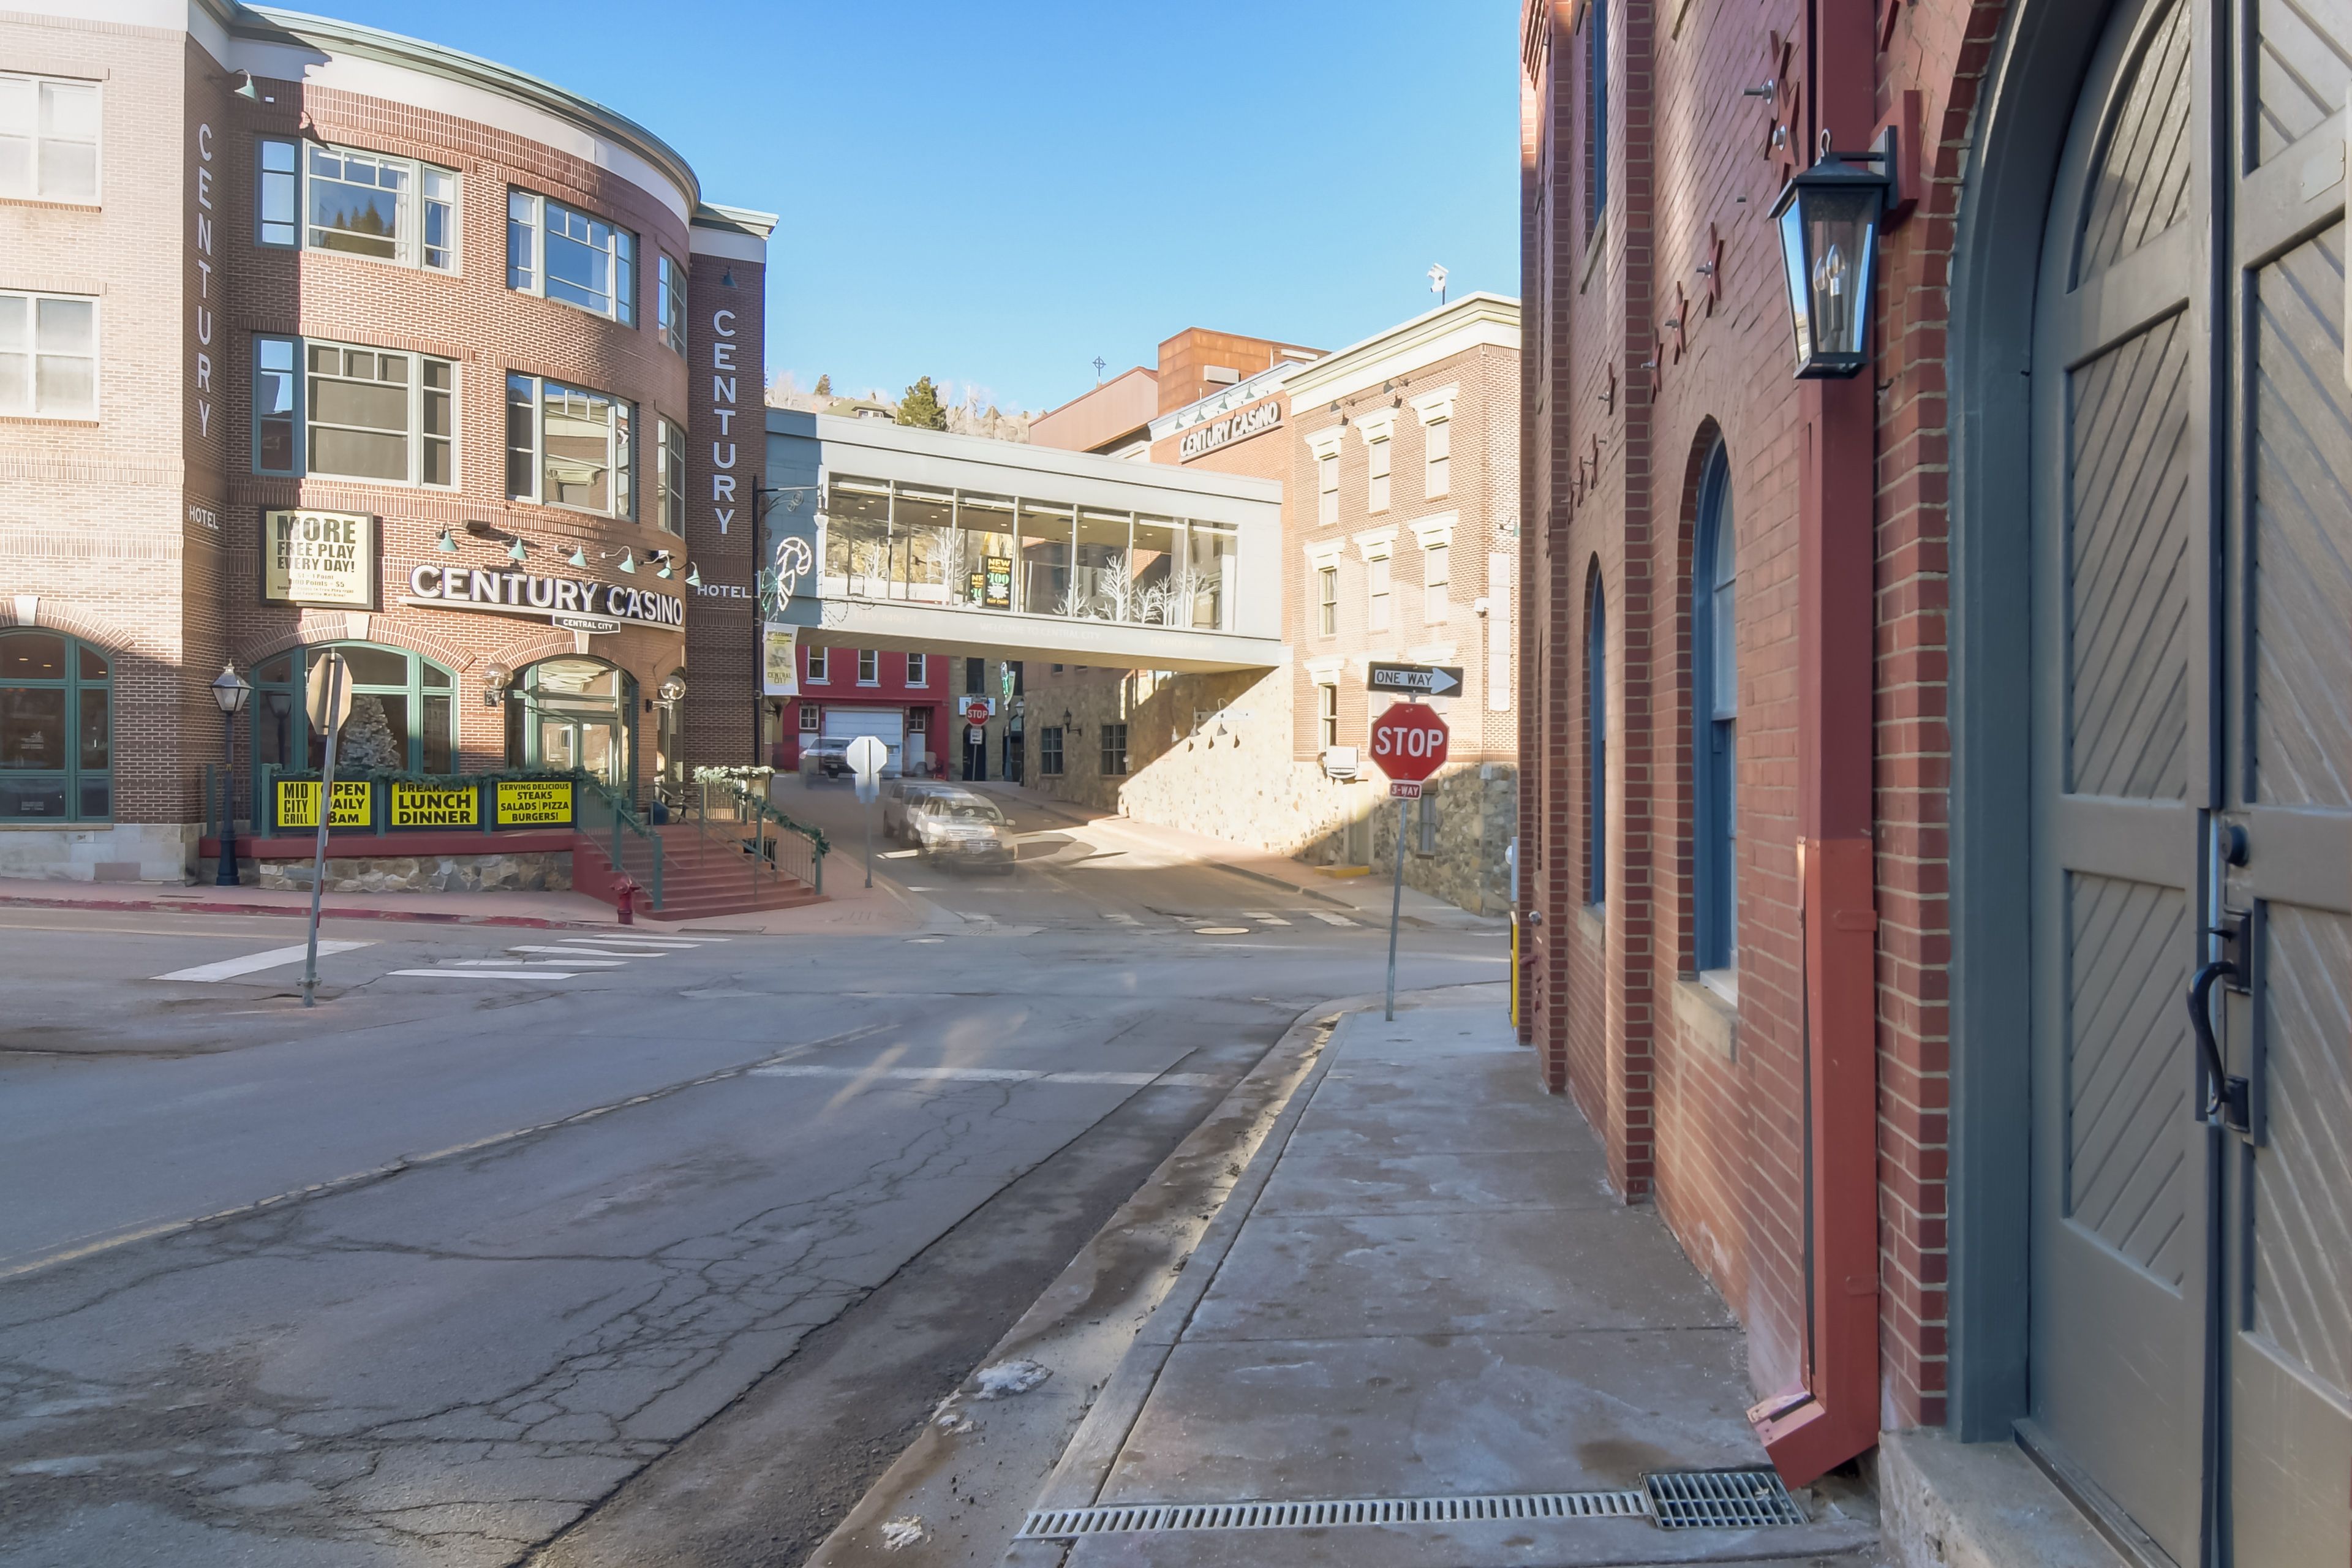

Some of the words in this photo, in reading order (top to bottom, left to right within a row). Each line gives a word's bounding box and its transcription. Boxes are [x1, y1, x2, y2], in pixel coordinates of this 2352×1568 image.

[198, 123, 213, 438] CENTURY
[713, 309, 736, 535] CENTURY
[1180, 419, 1231, 457] CENTURY
[1232, 401, 1278, 437] CASINO
[189, 504, 219, 530] HOTEL
[277, 516, 356, 544] MORE
[277, 541, 313, 556] FREE
[318, 544, 355, 559] PLAY
[277, 557, 319, 570] EVERY
[324, 559, 355, 573] DAY!
[988, 558, 1011, 567] NEW
[410, 564, 598, 612] CENTURY
[606, 584, 683, 625] CASINO
[697, 584, 752, 599] HOTEL
[563, 618, 596, 629] CENTRAL
[597, 621, 612, 631] CITY
[980, 622, 1025, 635] WELCOME
[1028, 626, 1039, 636] TO
[1041, 627, 1079, 638] CENTRAL
[1376, 671, 1401, 684] ONE
[1408, 673, 1433, 686] WAY
[968, 709, 988, 718] STOP
[1375, 726, 1444, 758] STOP
[284, 783, 308, 799] MID
[321, 784, 366, 796] PEN
[518, 791, 552, 800] STEAKS
[1392, 785, 1419, 796] 3-WAY
[284, 800, 308, 813] CITY
[331, 798, 365, 809] AILY
[399, 794, 470, 809] LUNCH
[501, 802, 537, 811] SALADS
[284, 813, 308, 824] GRILL
[330, 811, 360, 823] 8AM
[399, 810, 471, 824] DINNER
[512, 812, 559, 821] BURGERS!
